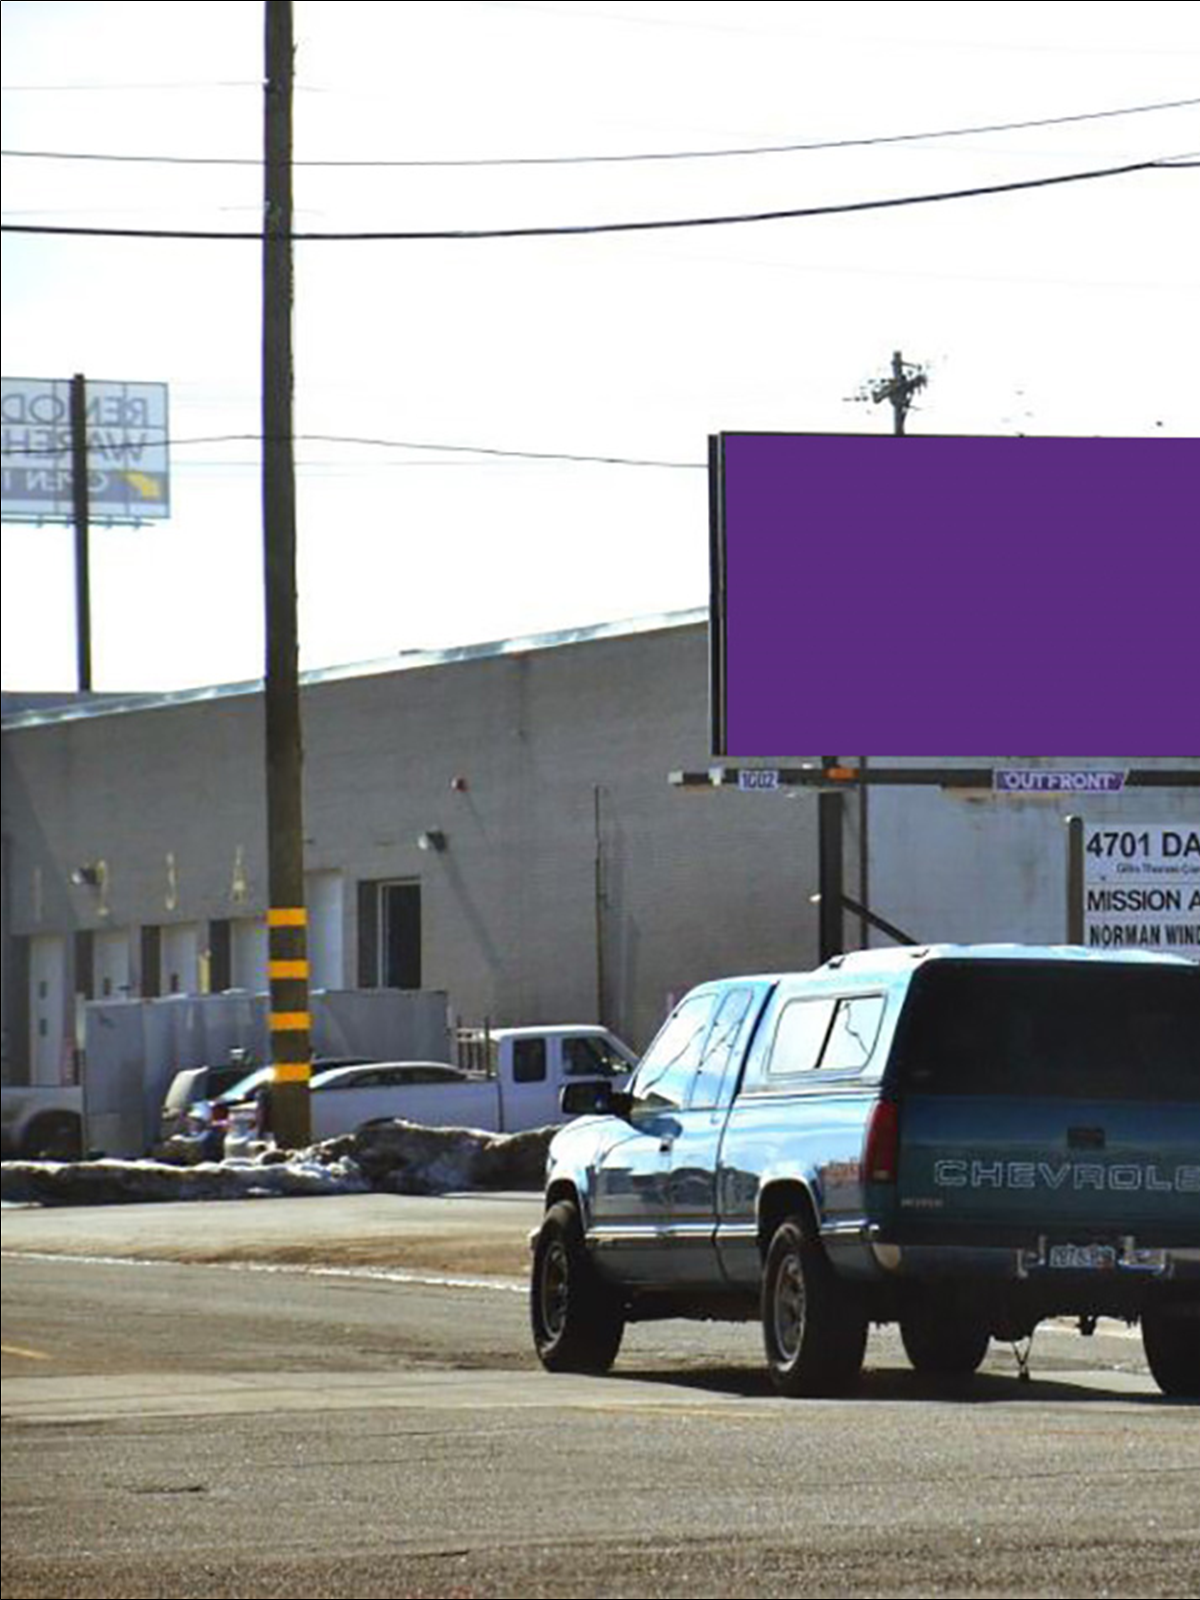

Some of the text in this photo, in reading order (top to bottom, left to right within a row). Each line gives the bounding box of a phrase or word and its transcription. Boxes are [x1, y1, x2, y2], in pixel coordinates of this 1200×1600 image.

[1005, 772, 1115, 789] OUTFRONT
[1086, 832, 1150, 857] 4701
[1087, 889, 1181, 912] MISSION
[1089, 923, 1161, 946] NORMAN
